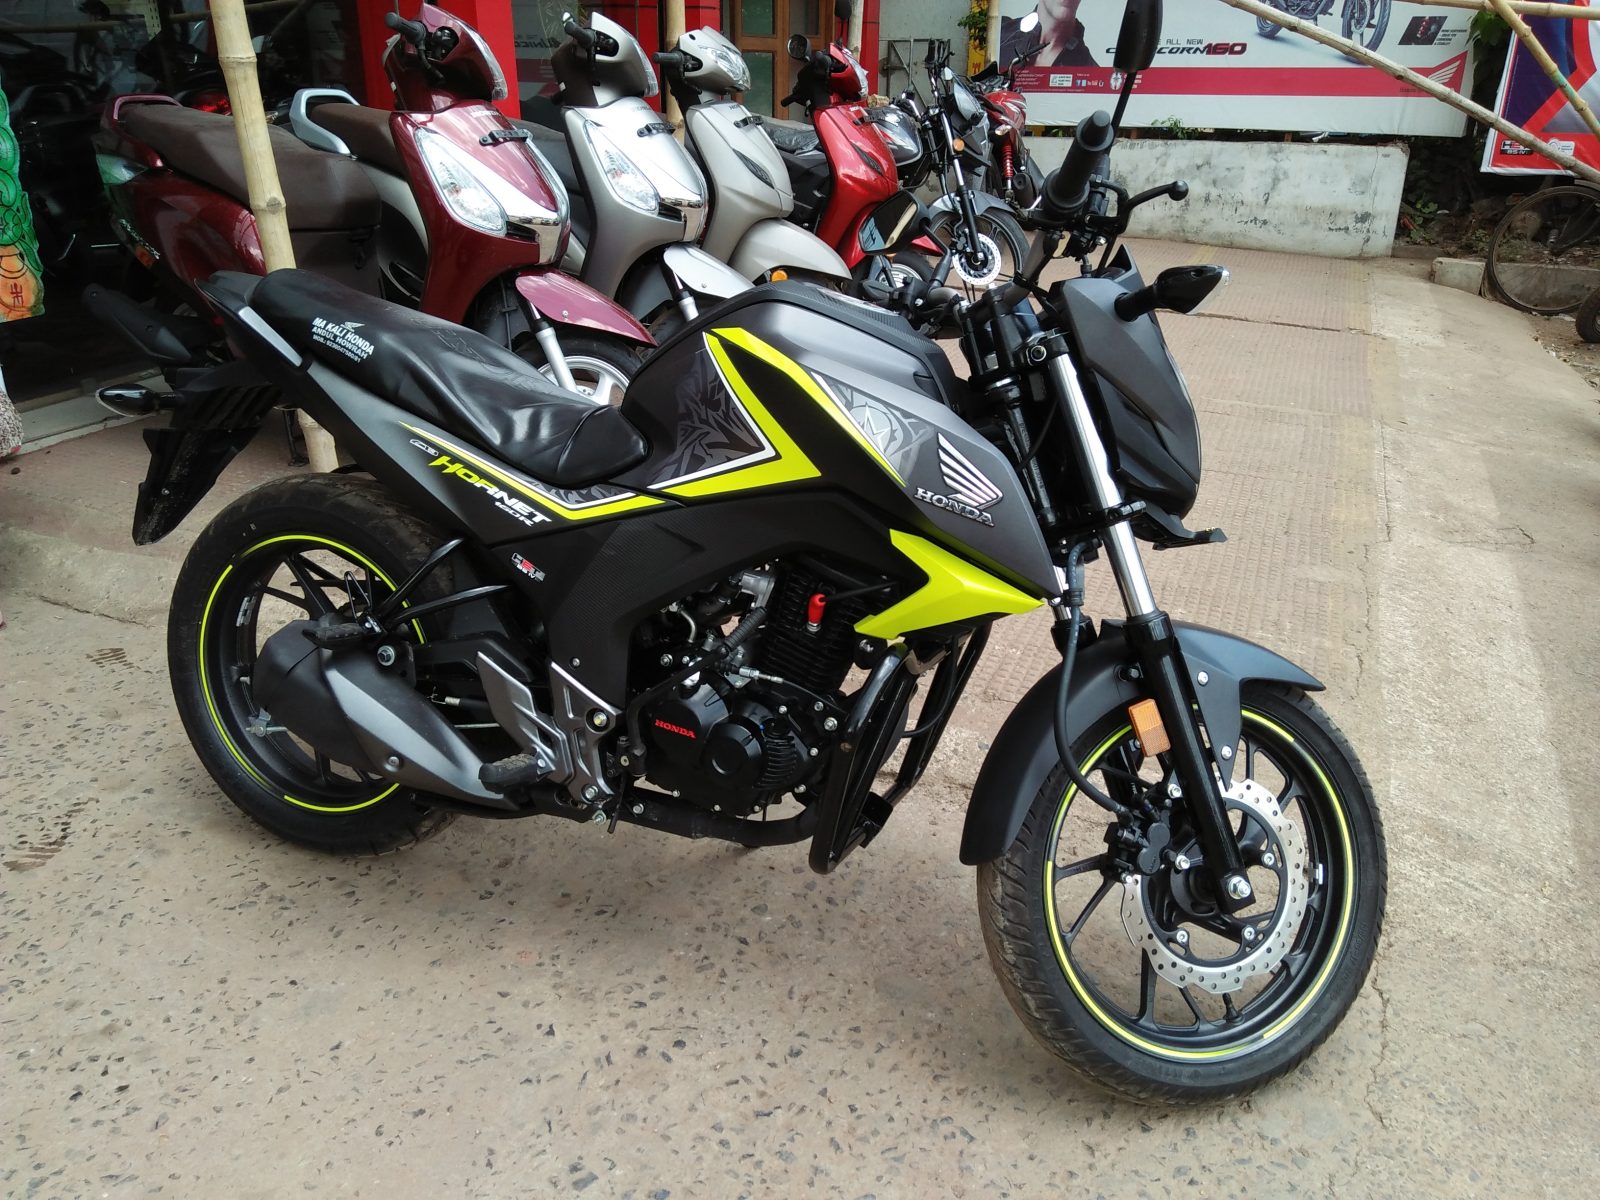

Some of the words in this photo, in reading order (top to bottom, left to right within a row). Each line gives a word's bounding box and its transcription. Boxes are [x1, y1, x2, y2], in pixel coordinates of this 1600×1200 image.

[1165, 38, 1181, 46] ALL
[1186, 38, 1204, 46] NEW
[311, 326, 335, 341] ANDUL
[335, 336, 369, 360] HOWRAH
[312, 317, 327, 329] MA
[325, 322, 348, 337] KALI
[345, 331, 375, 356] HONDA
[427, 455, 553, 524] HORNET
[914, 486, 995, 527] HONDA
[494, 500, 535, 527] 160R
[654, 718, 697, 739] HONDA
